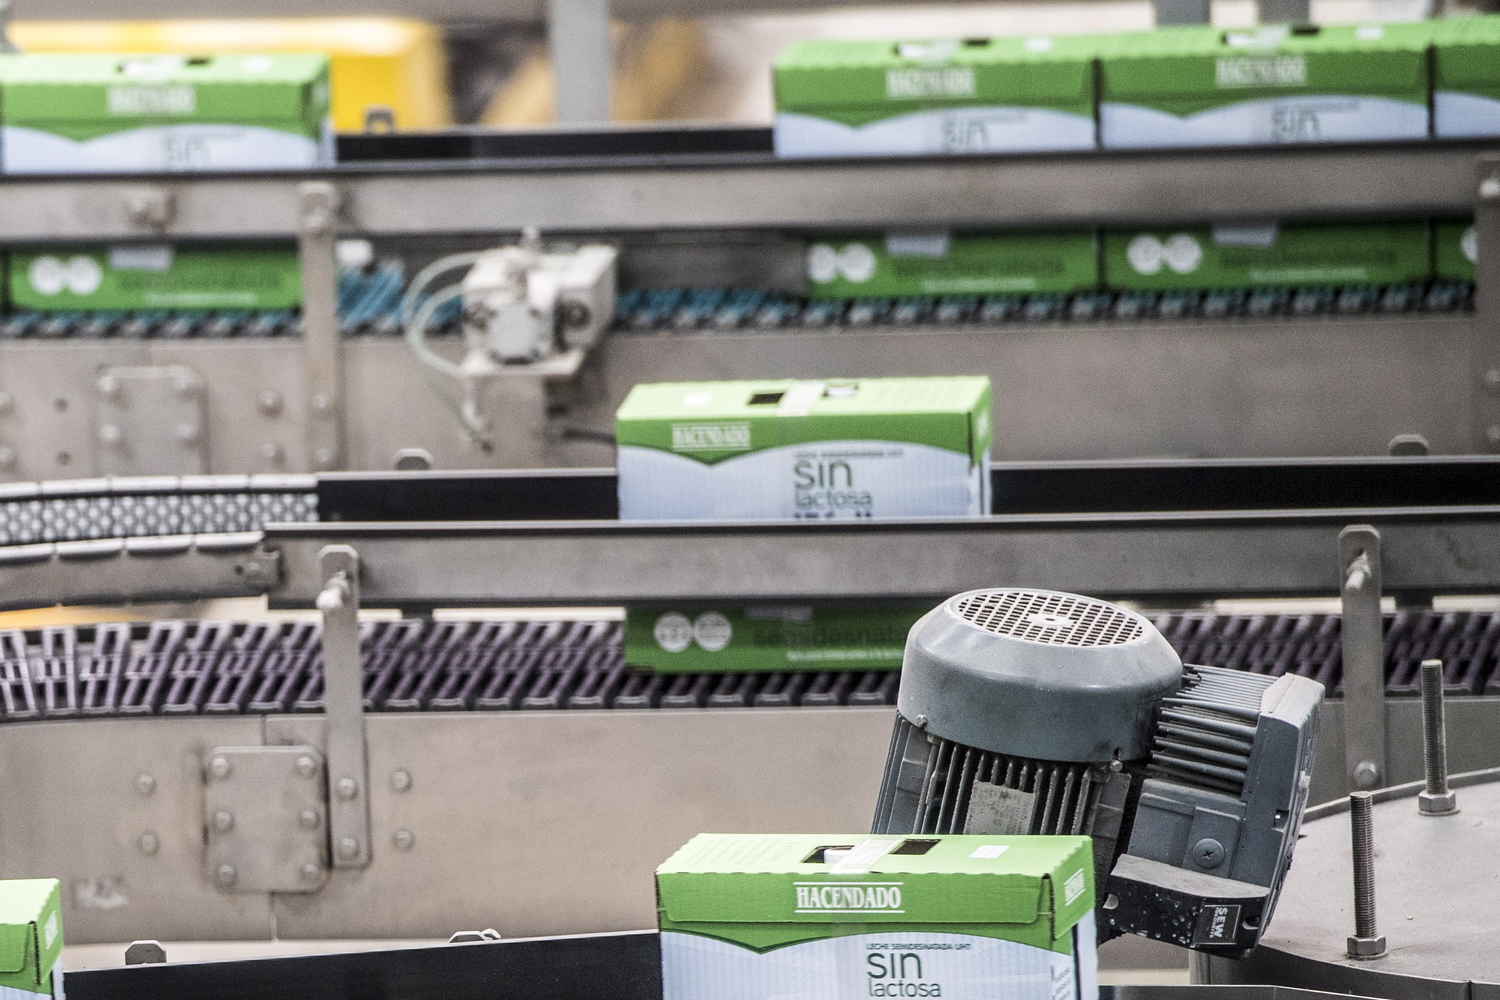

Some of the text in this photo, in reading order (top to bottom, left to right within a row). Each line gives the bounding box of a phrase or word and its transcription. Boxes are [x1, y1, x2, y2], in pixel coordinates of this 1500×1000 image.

[794, 460, 852, 490] sin
[796, 886, 902, 909] HACENDADO
[866, 952, 922, 979] sin
[867, 977, 941, 997] lactosa
